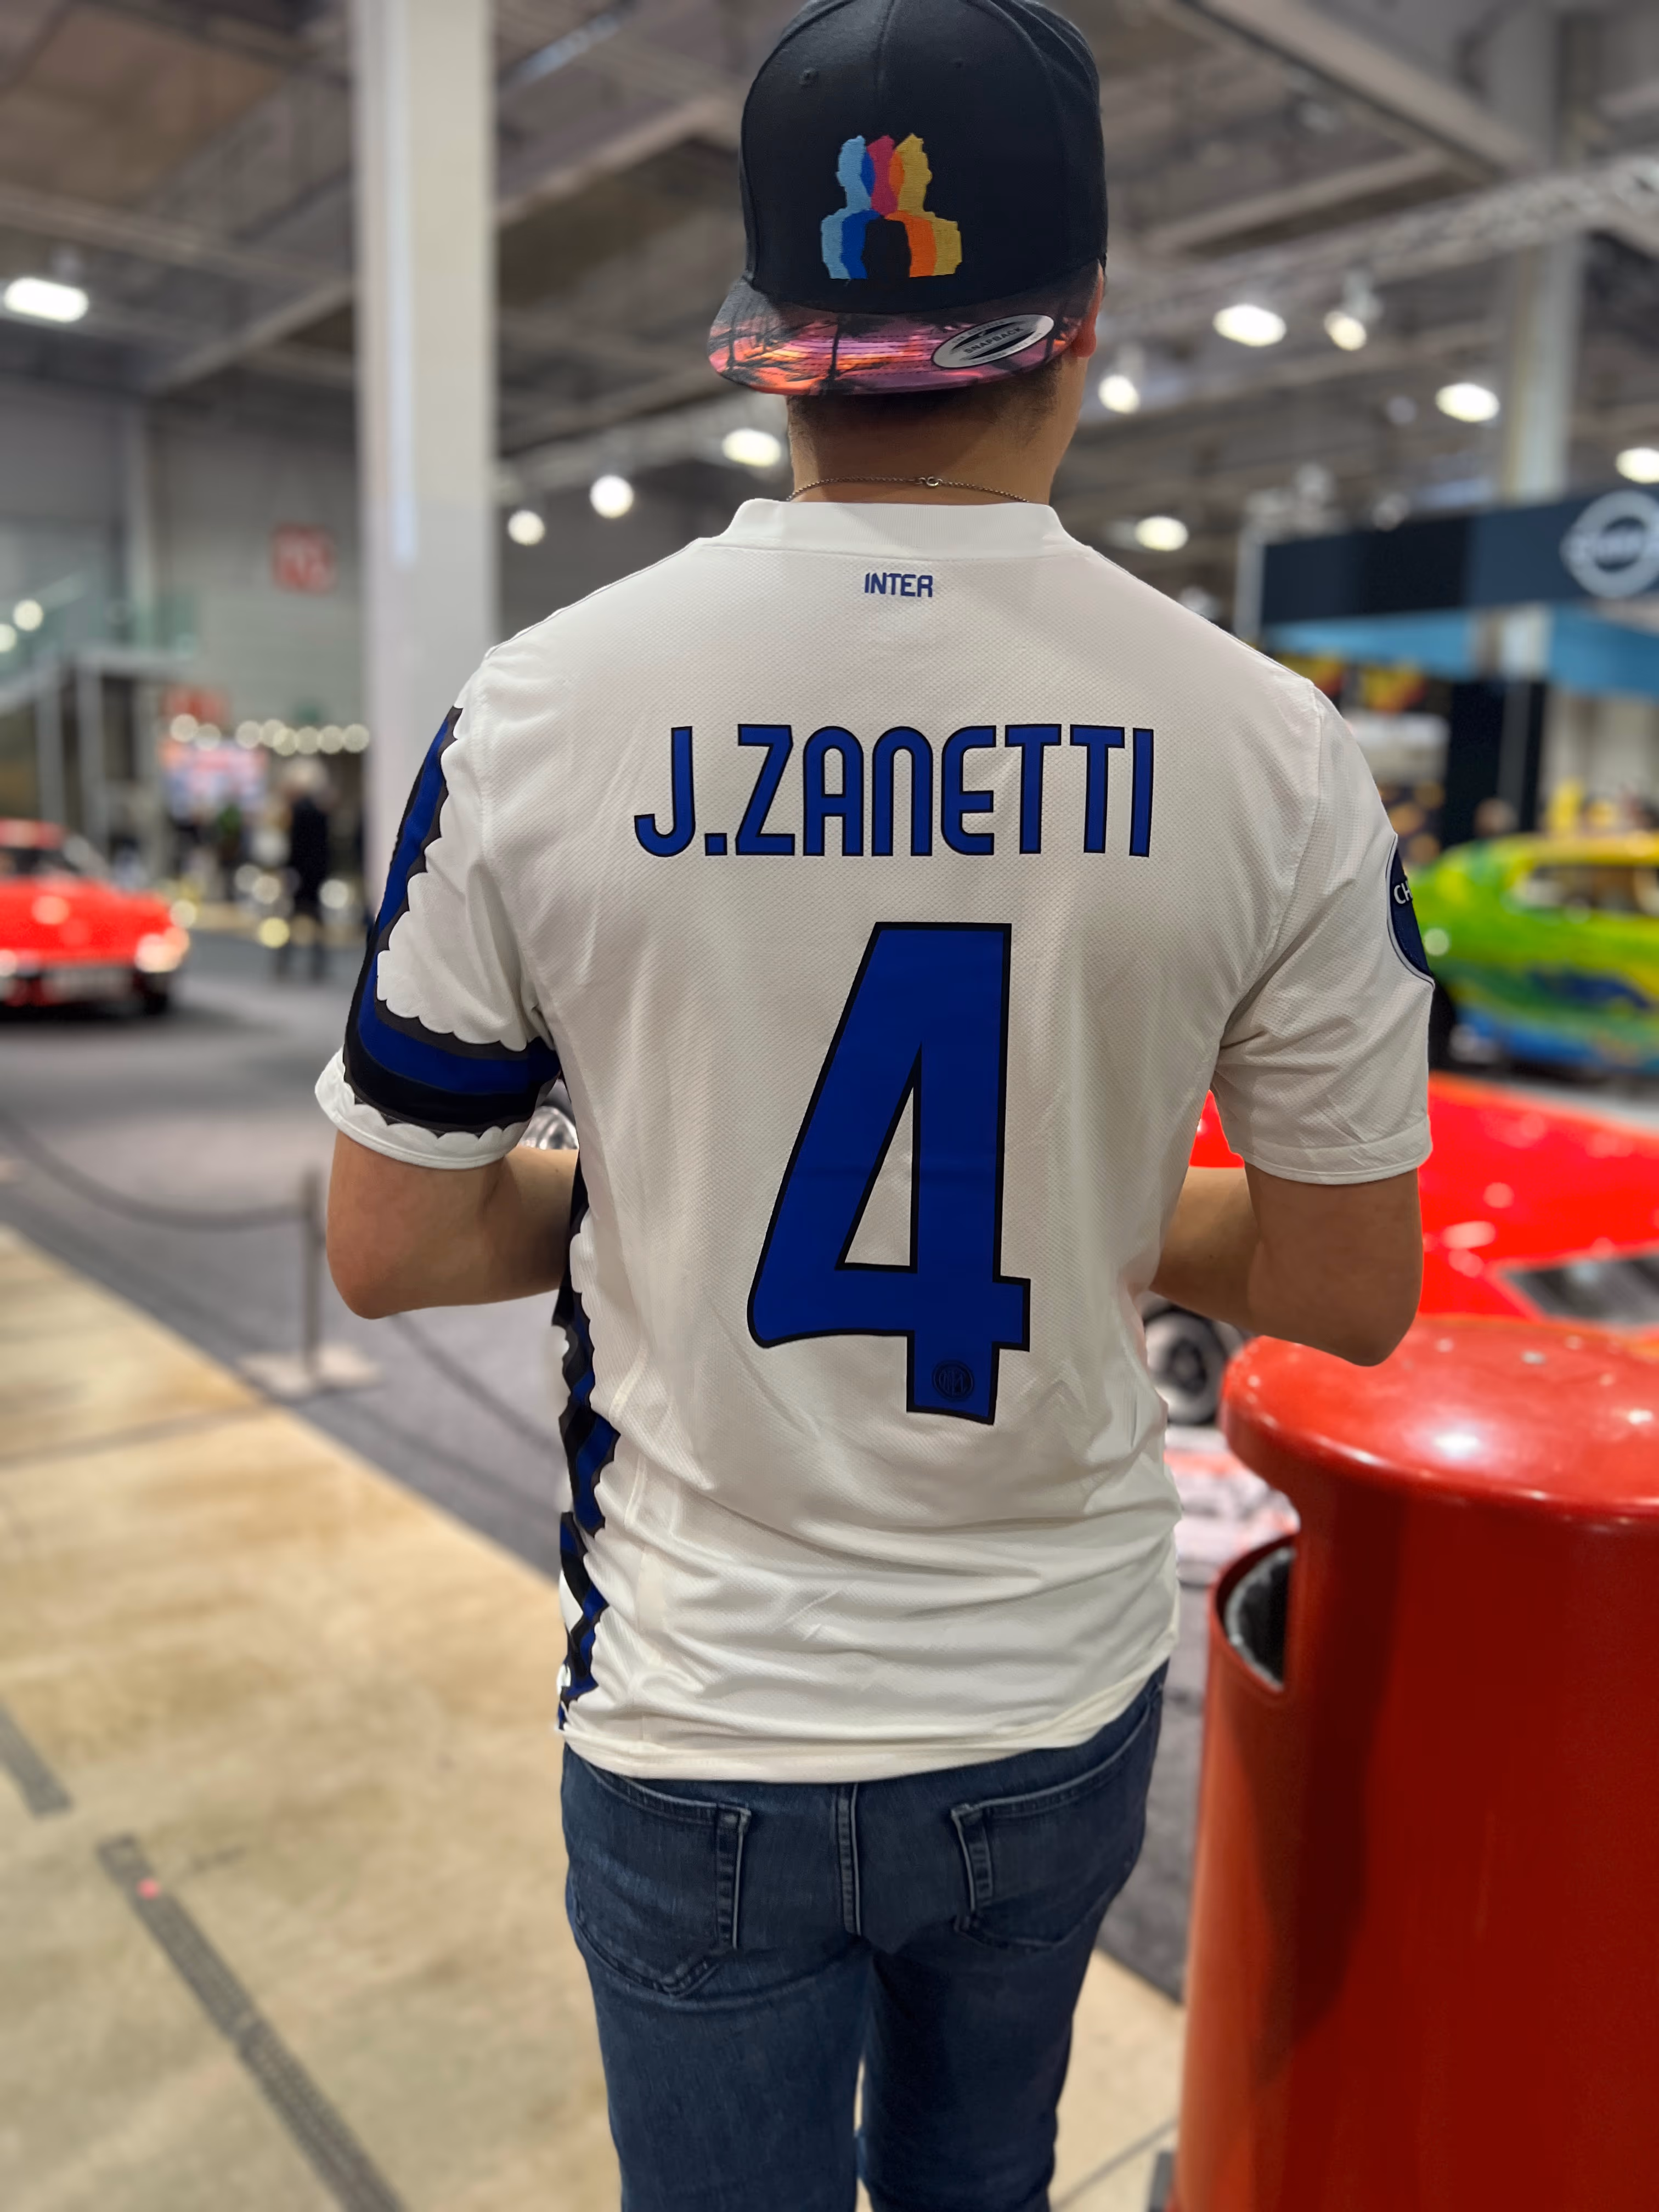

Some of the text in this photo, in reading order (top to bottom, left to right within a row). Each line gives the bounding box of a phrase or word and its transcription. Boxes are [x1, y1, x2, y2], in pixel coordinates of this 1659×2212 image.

[963, 327, 1024, 354] SNAPBACK
[865, 573, 933, 597] INTER
[634, 724, 1153, 857] J.ZANETTI
[747, 922, 1030, 1425] 4
